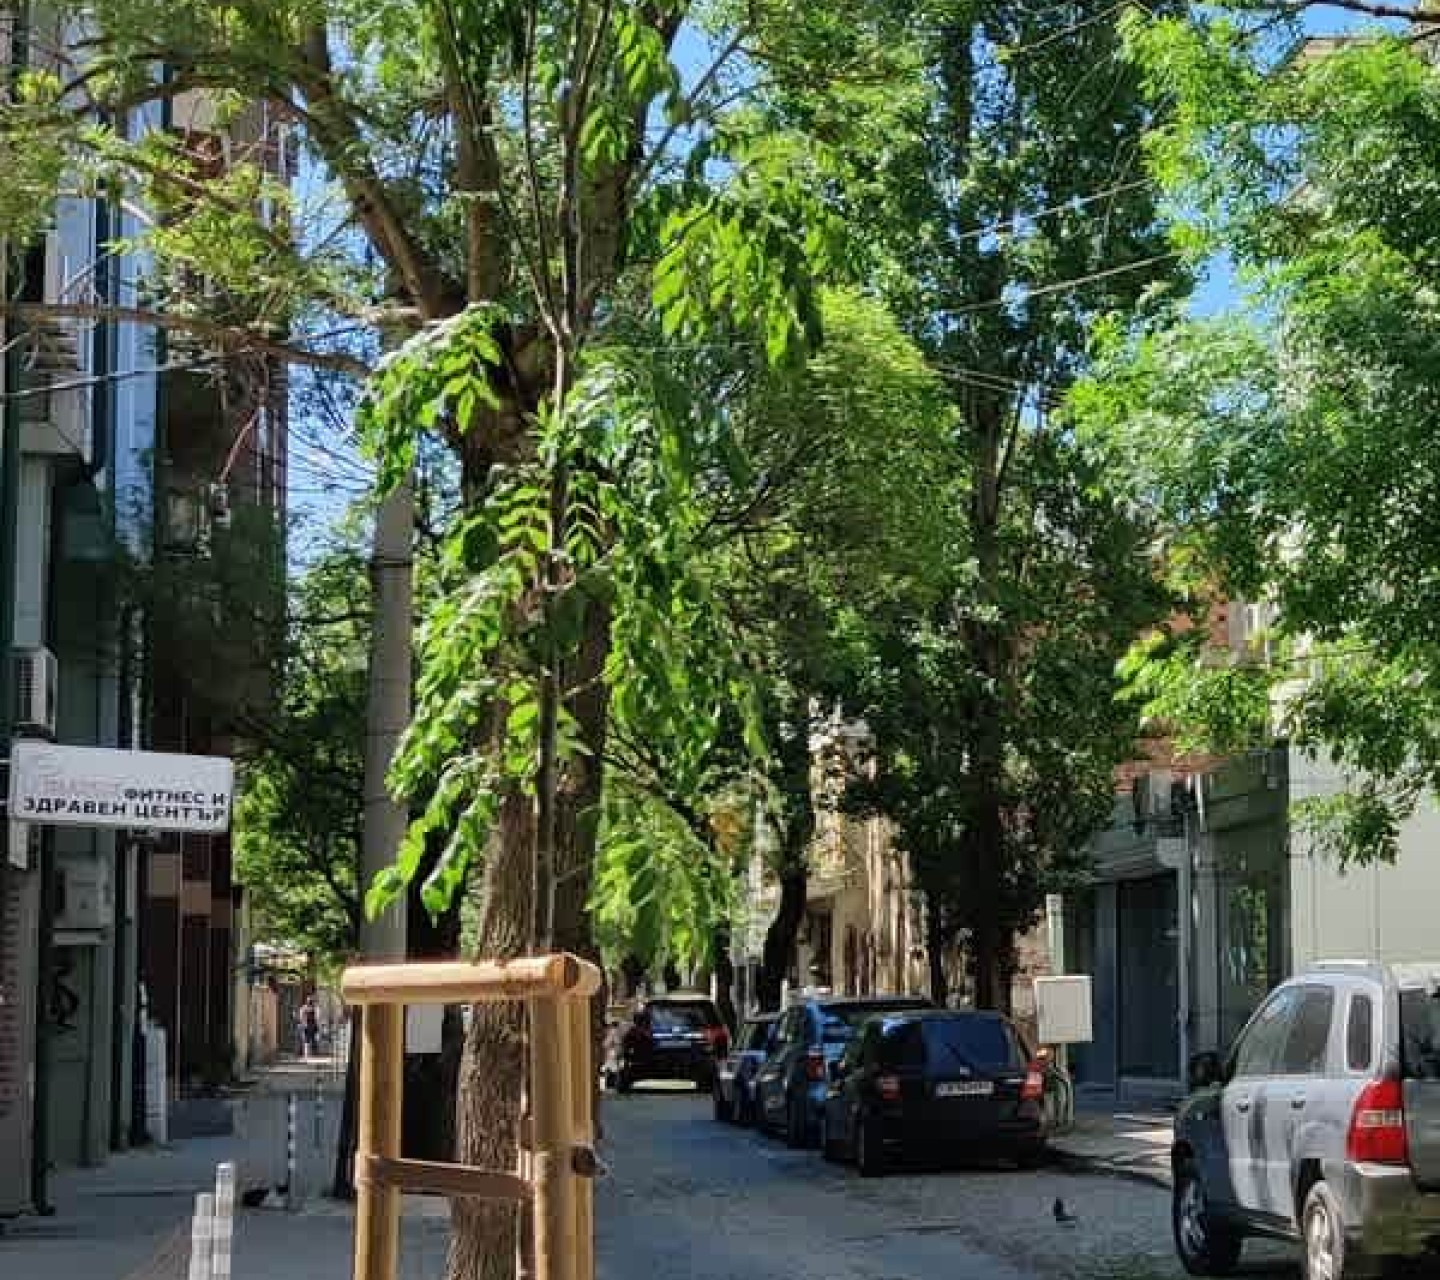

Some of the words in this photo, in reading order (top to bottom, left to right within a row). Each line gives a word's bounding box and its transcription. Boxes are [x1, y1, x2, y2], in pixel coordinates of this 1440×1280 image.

[124, 787, 205, 804] ФИТНЕС
[23, 795, 126, 814] ЗДРАВЕН
[135, 803, 225, 821] ЦЕНТЪР
